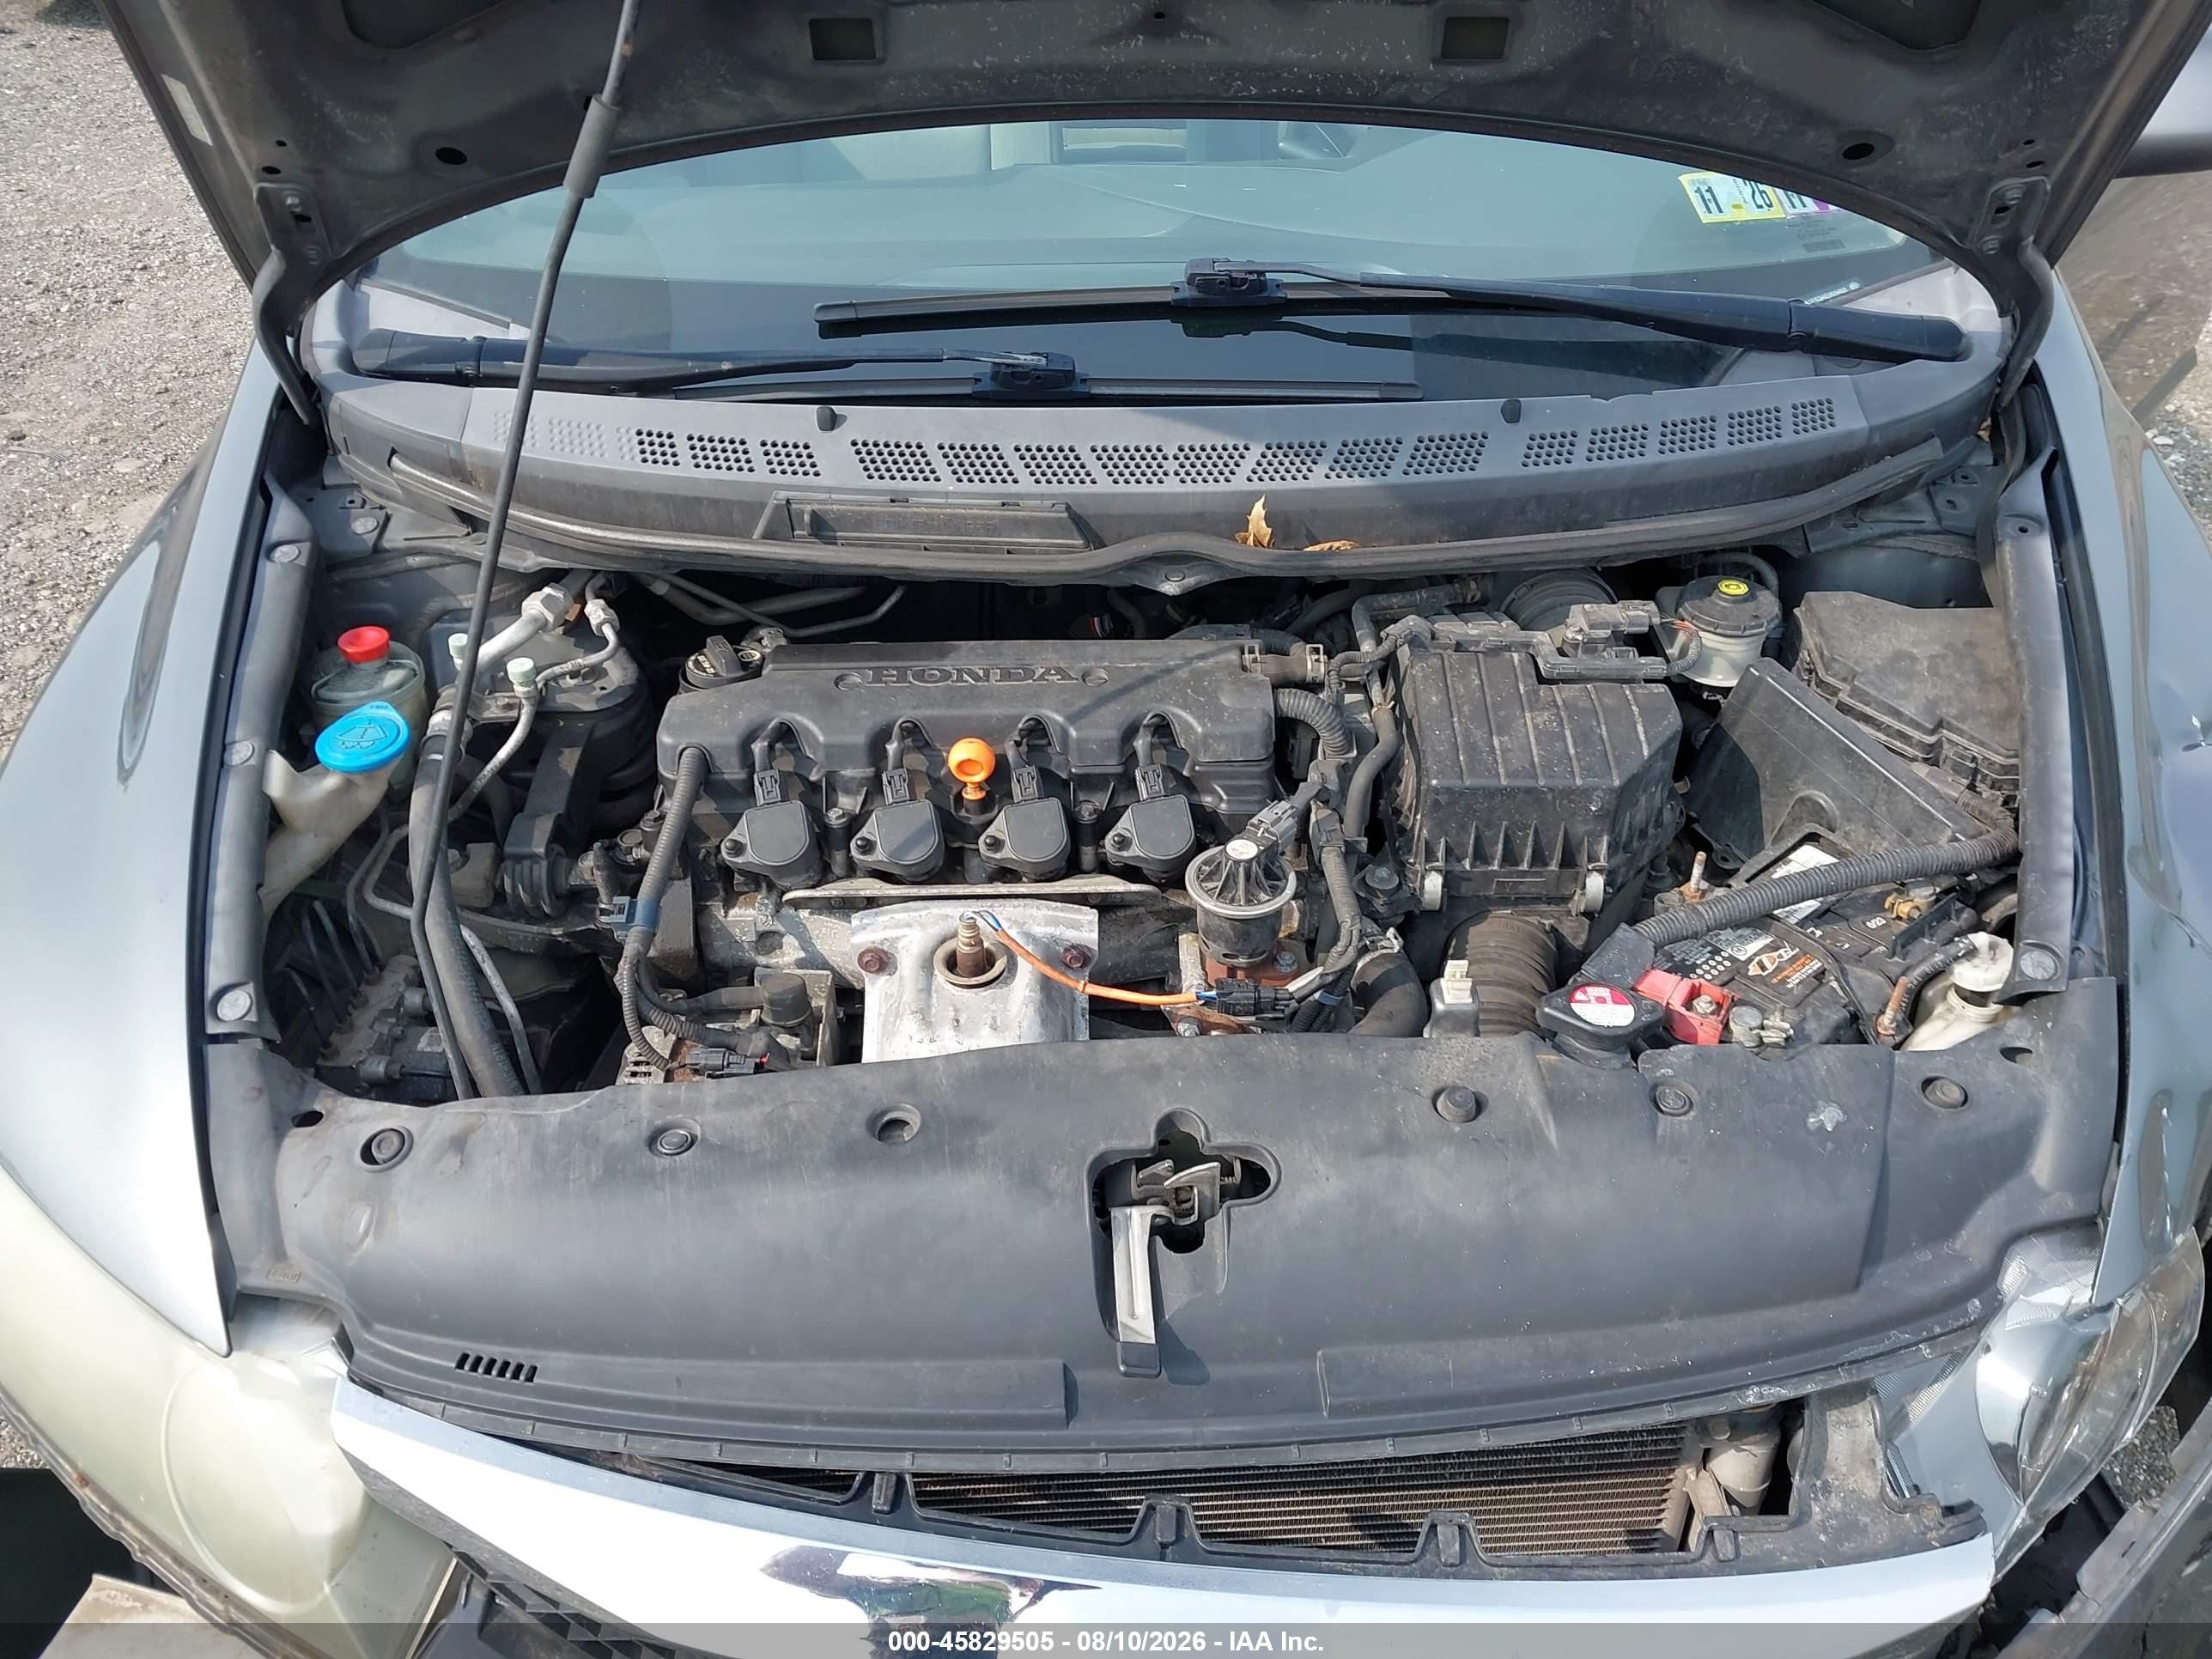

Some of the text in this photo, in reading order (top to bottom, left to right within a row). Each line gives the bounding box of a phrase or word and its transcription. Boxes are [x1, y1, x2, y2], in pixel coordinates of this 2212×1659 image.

[1693, 185, 1723, 214] 11
[1744, 178, 1773, 210] 26
[866, 665, 1079, 688] HONDA
